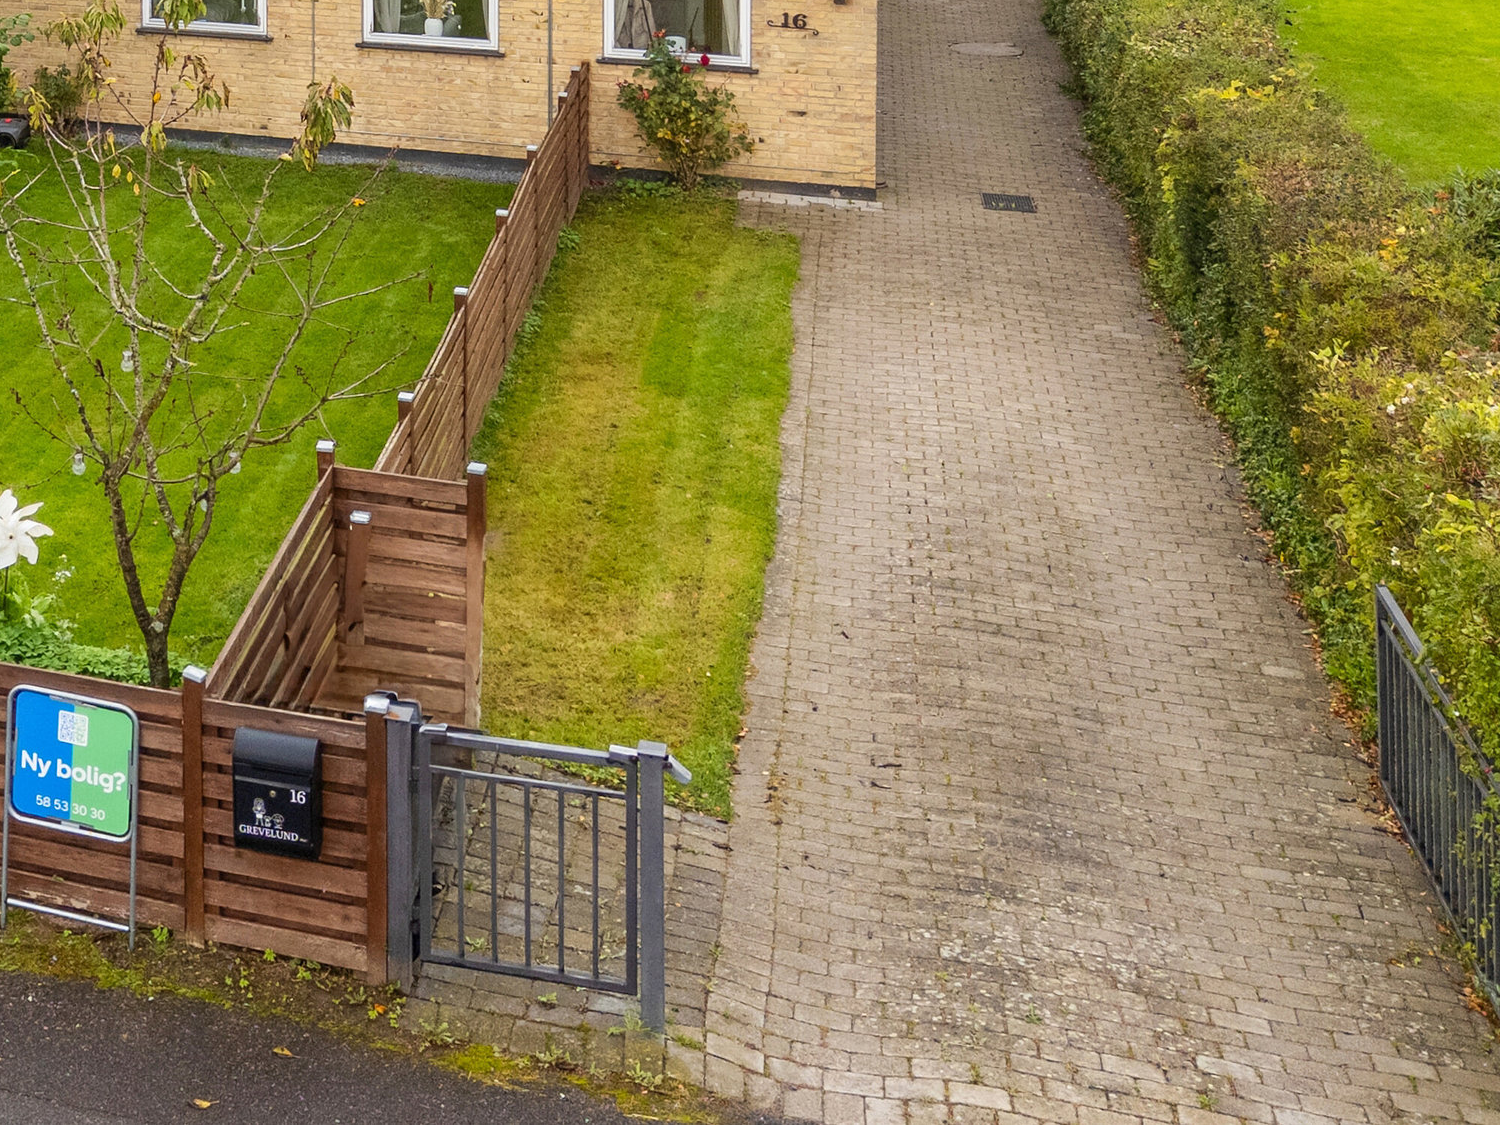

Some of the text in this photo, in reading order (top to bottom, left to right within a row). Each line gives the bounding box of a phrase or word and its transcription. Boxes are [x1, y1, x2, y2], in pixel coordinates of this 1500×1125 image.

[781, 12, 808, 29] 16
[21, 749, 126, 793] Ny bolig?
[290, 789, 306, 804] 16
[35, 794, 106, 821] 58 53 30 30
[239, 824, 299, 842] GREVELUND
